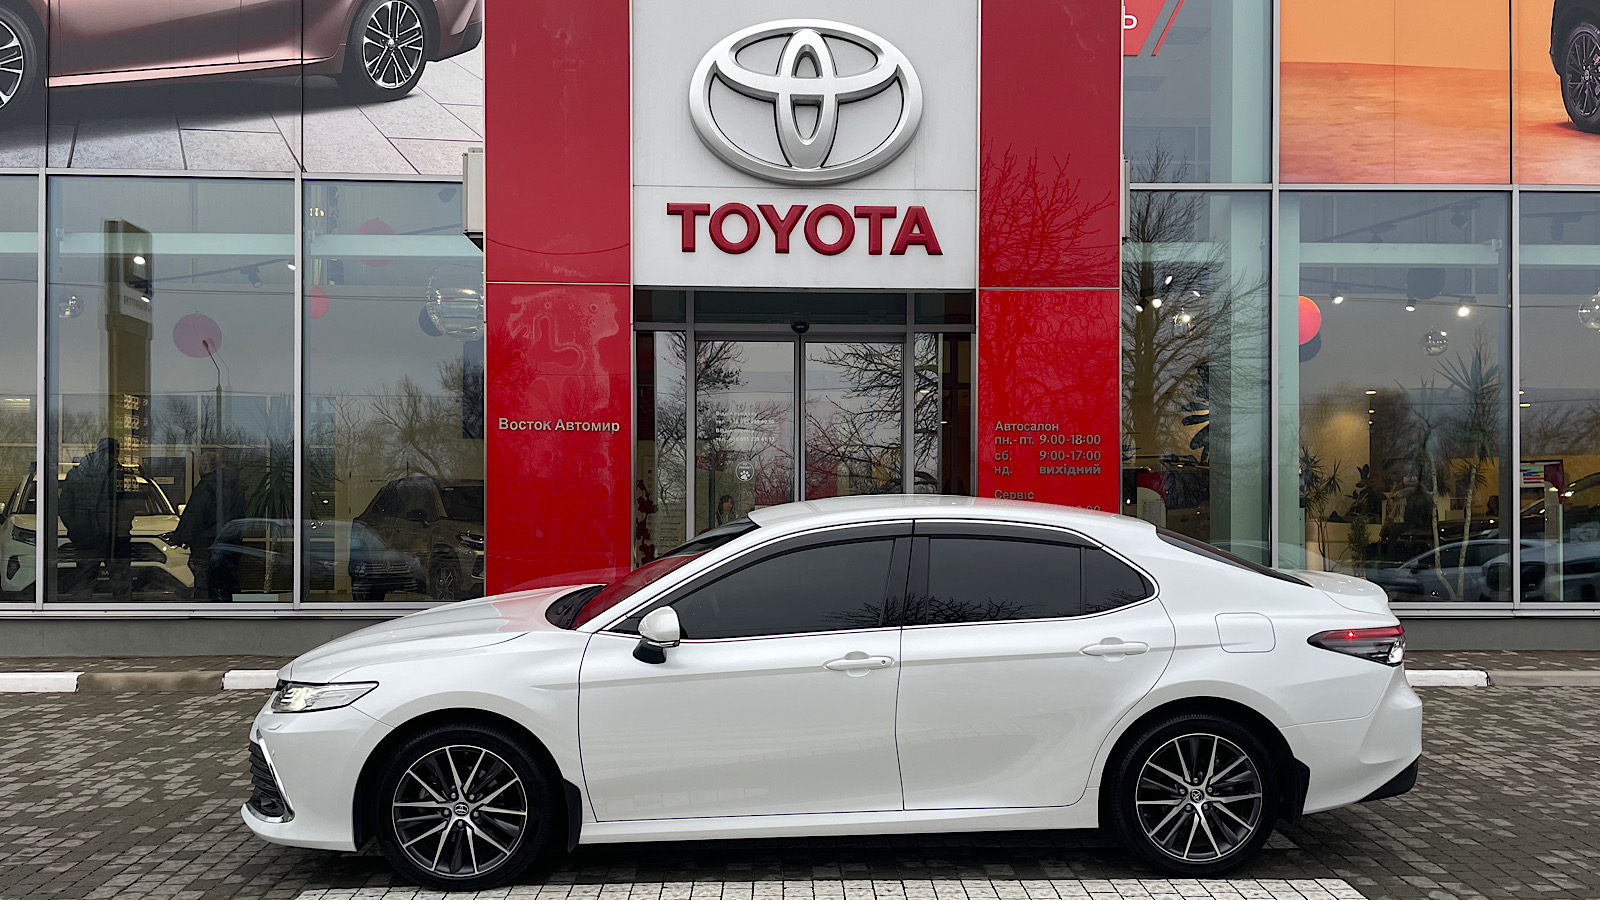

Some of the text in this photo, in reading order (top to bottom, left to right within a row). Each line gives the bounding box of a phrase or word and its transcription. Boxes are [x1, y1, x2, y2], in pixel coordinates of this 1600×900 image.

[667, 202, 944, 256] TOYOTA
[499, 418, 620, 434] Восток Автомир
[995, 421, 1059, 431] Автосалон
[1039, 434, 1101, 445] 9:00-18:00
[994, 450, 1101, 461] сб. 9:00-17:00
[994, 463, 1101, 476] нд. вихідний
[994, 489, 1034, 500] Сервіс
